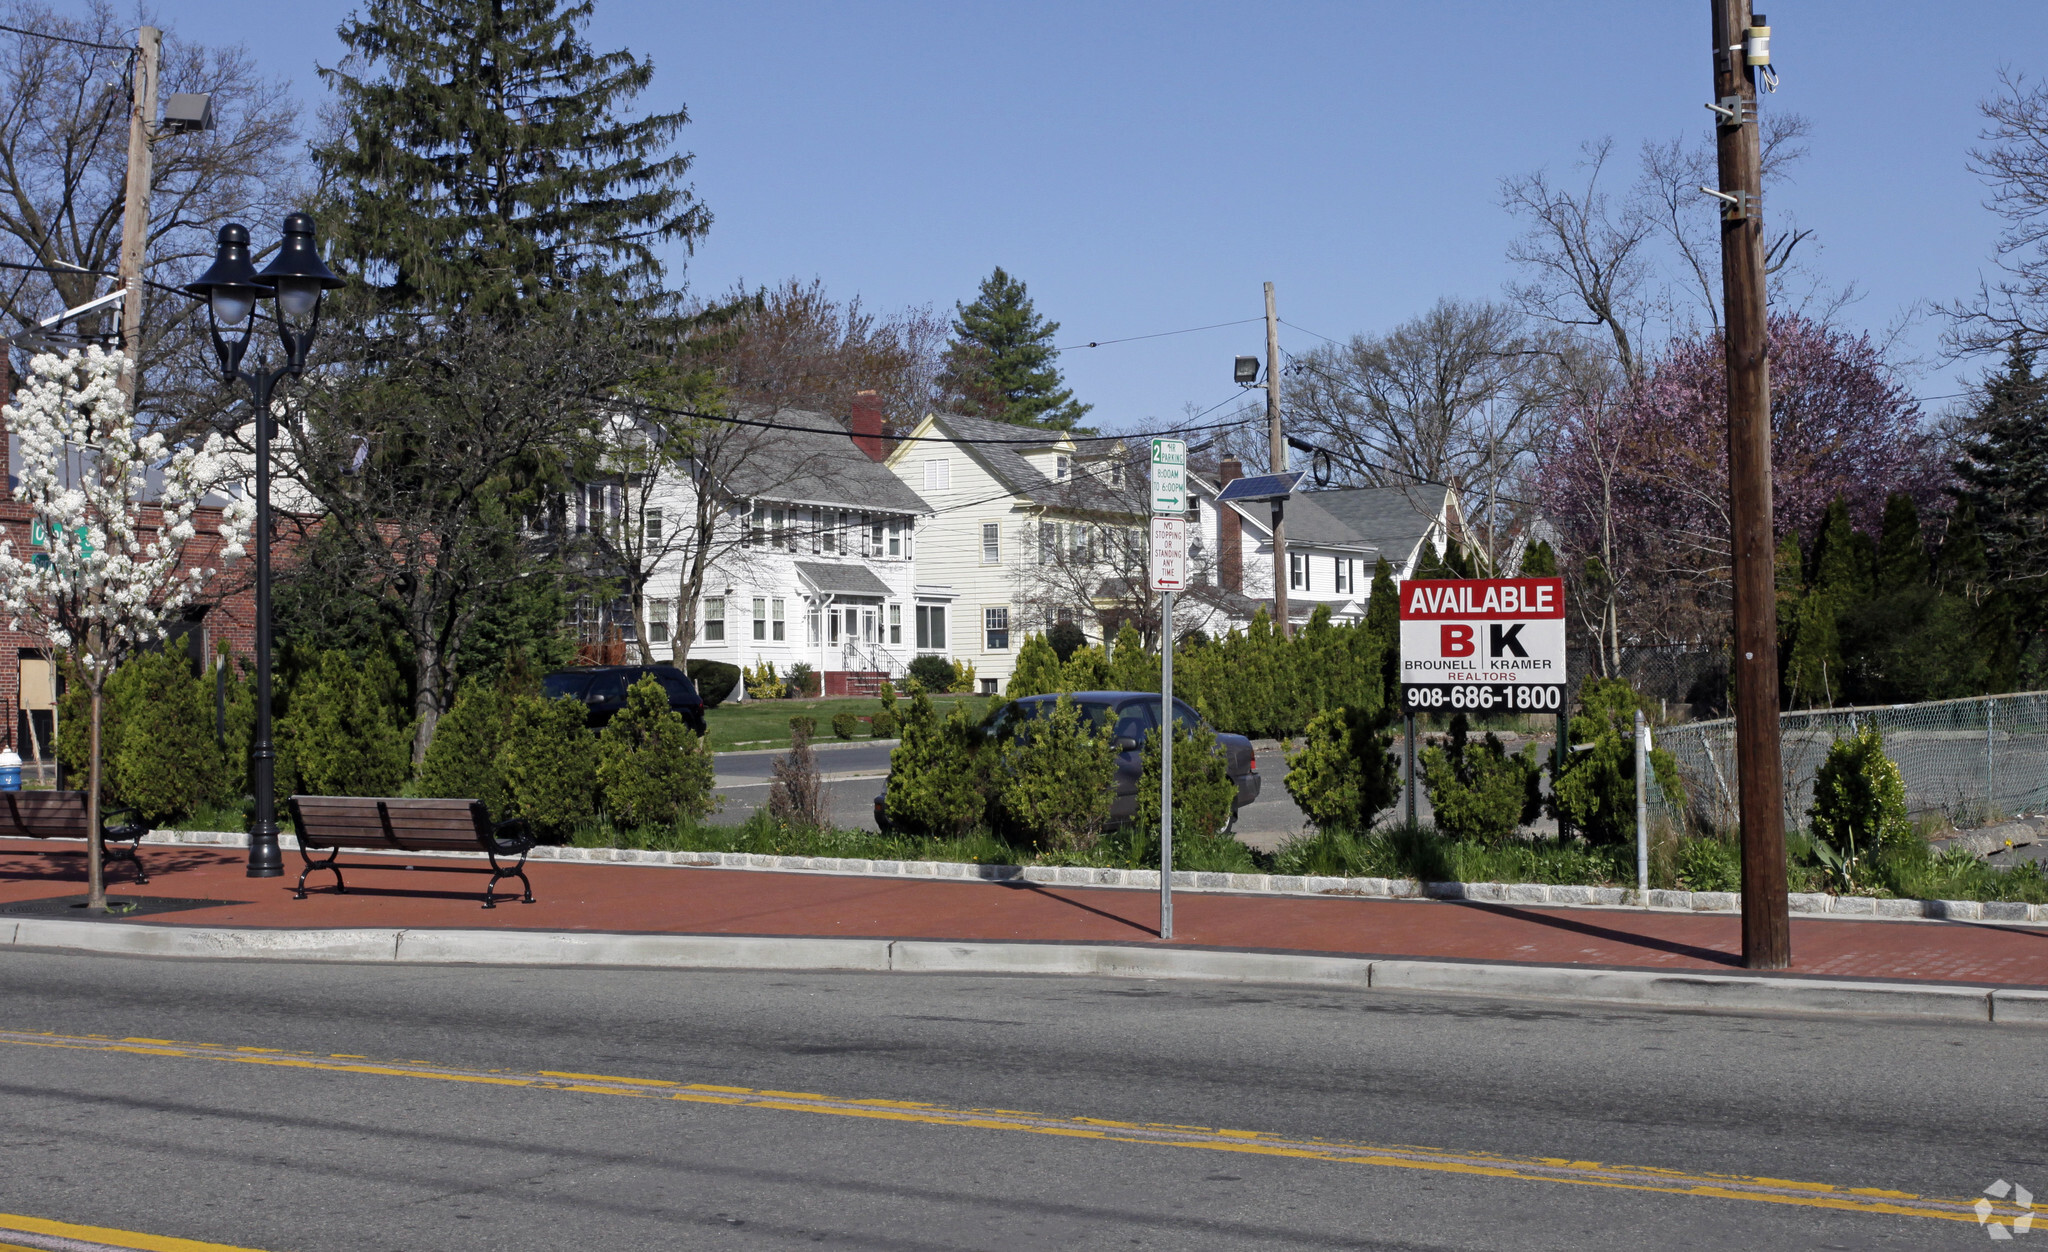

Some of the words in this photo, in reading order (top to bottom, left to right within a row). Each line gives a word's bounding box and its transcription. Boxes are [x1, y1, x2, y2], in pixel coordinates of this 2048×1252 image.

[1168, 443, 1176, 452] HR
[1153, 445, 1160, 461] 2
[1162, 453, 1183, 463] PARKING
[1157, 469, 1179, 479] 8:00AM
[1153, 482, 1160, 491] TO
[1162, 482, 1183, 492] 6:00PM
[1163, 522, 1173, 530] NO
[1155, 531, 1182, 540] STOPPING
[1164, 540, 1173, 549] OR
[1155, 549, 1182, 558] STANDING
[1162, 559, 1173, 567] ANY
[1162, 568, 1175, 577] TIME
[1409, 585, 1554, 614] AVAILABLE
[1440, 624, 1475, 658] B
[1490, 623, 1529, 658] K
[1405, 660, 1477, 670] BROUNELL
[1490, 659, 1552, 670] KRAMER
[1448, 672, 1517, 681] REALTORS
[1407, 685, 1561, 709] 908-686-1800
